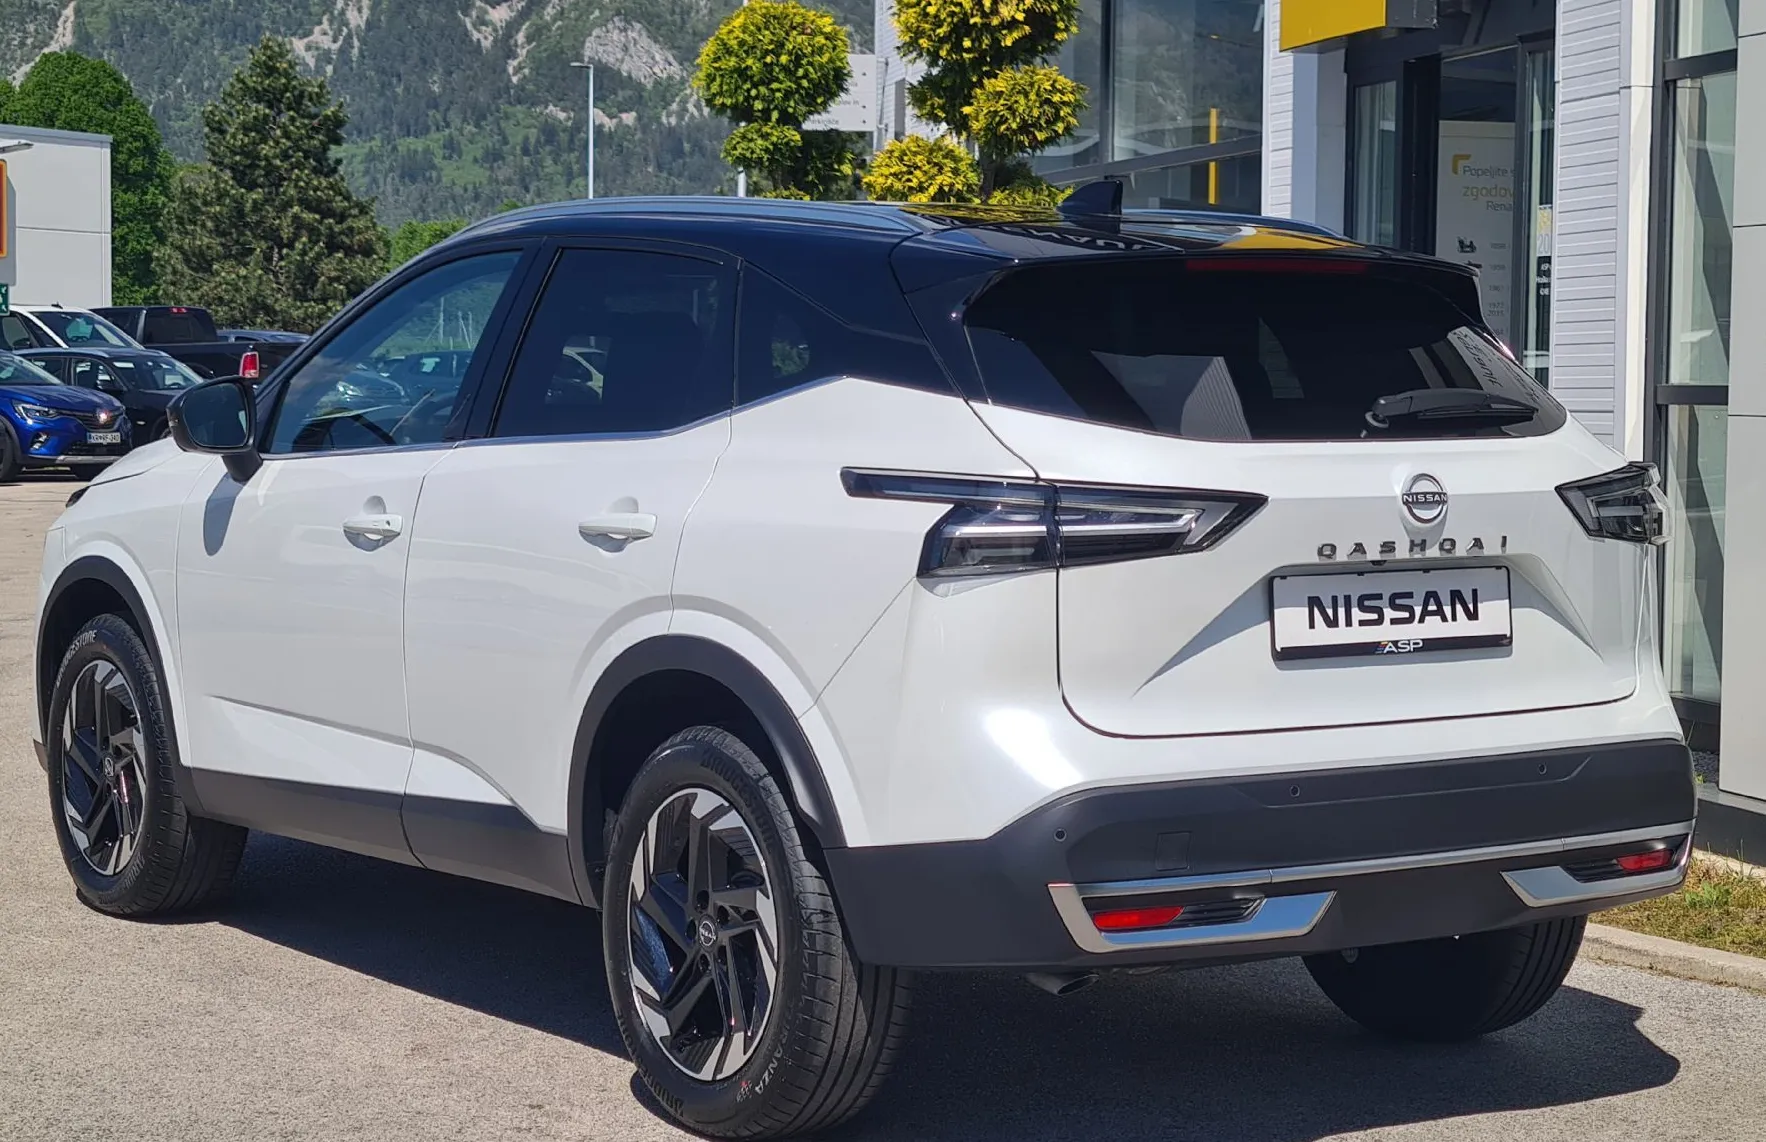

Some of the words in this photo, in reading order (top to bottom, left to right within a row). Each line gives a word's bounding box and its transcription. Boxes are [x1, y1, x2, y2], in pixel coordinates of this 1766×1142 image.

[1462, 164, 1508, 178] Popeljite
[1402, 493, 1448, 503] NISSAN
[1316, 535, 1508, 559] QASHQAI
[1306, 588, 1480, 630] NISSAN
[1381, 639, 1424, 654] ASP
